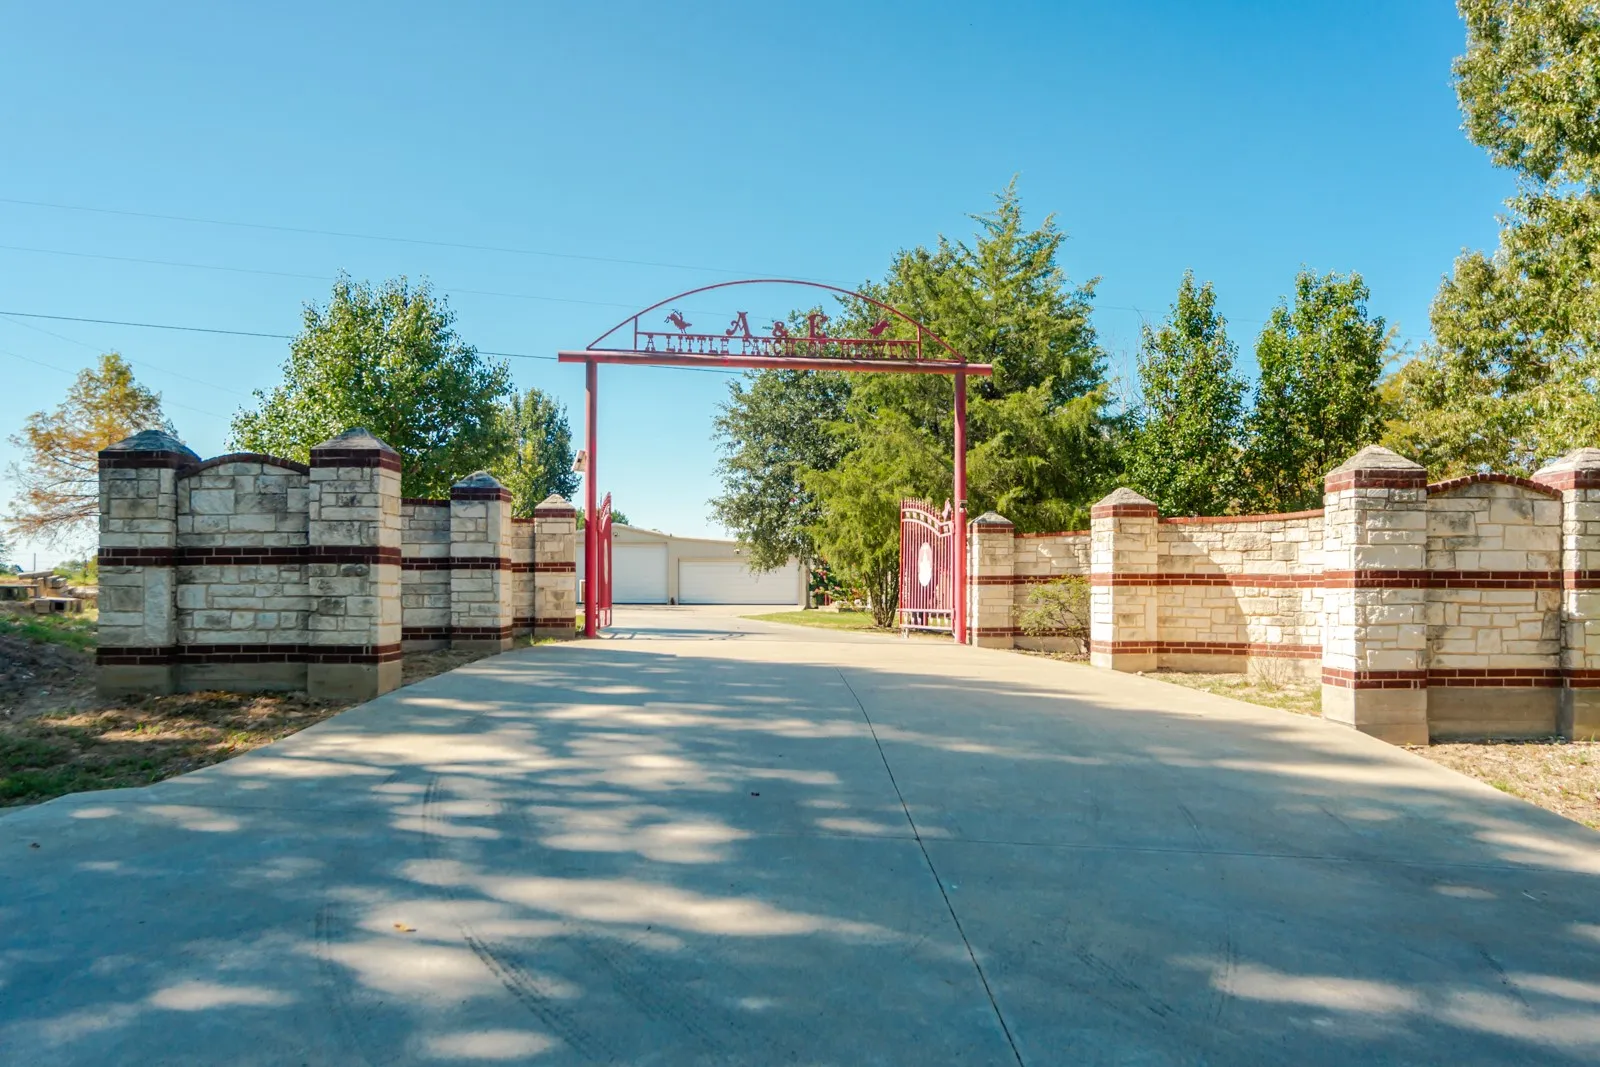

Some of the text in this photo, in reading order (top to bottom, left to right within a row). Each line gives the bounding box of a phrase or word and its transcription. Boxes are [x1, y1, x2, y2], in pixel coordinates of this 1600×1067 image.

[726, 311, 752, 338] A
[772, 321, 788, 338] &
[645, 334, 656, 352] A
[666, 334, 729, 355] LITTLE
[742, 336, 796, 357] PATCH
[841, 339, 912, 360] HEAVEN
